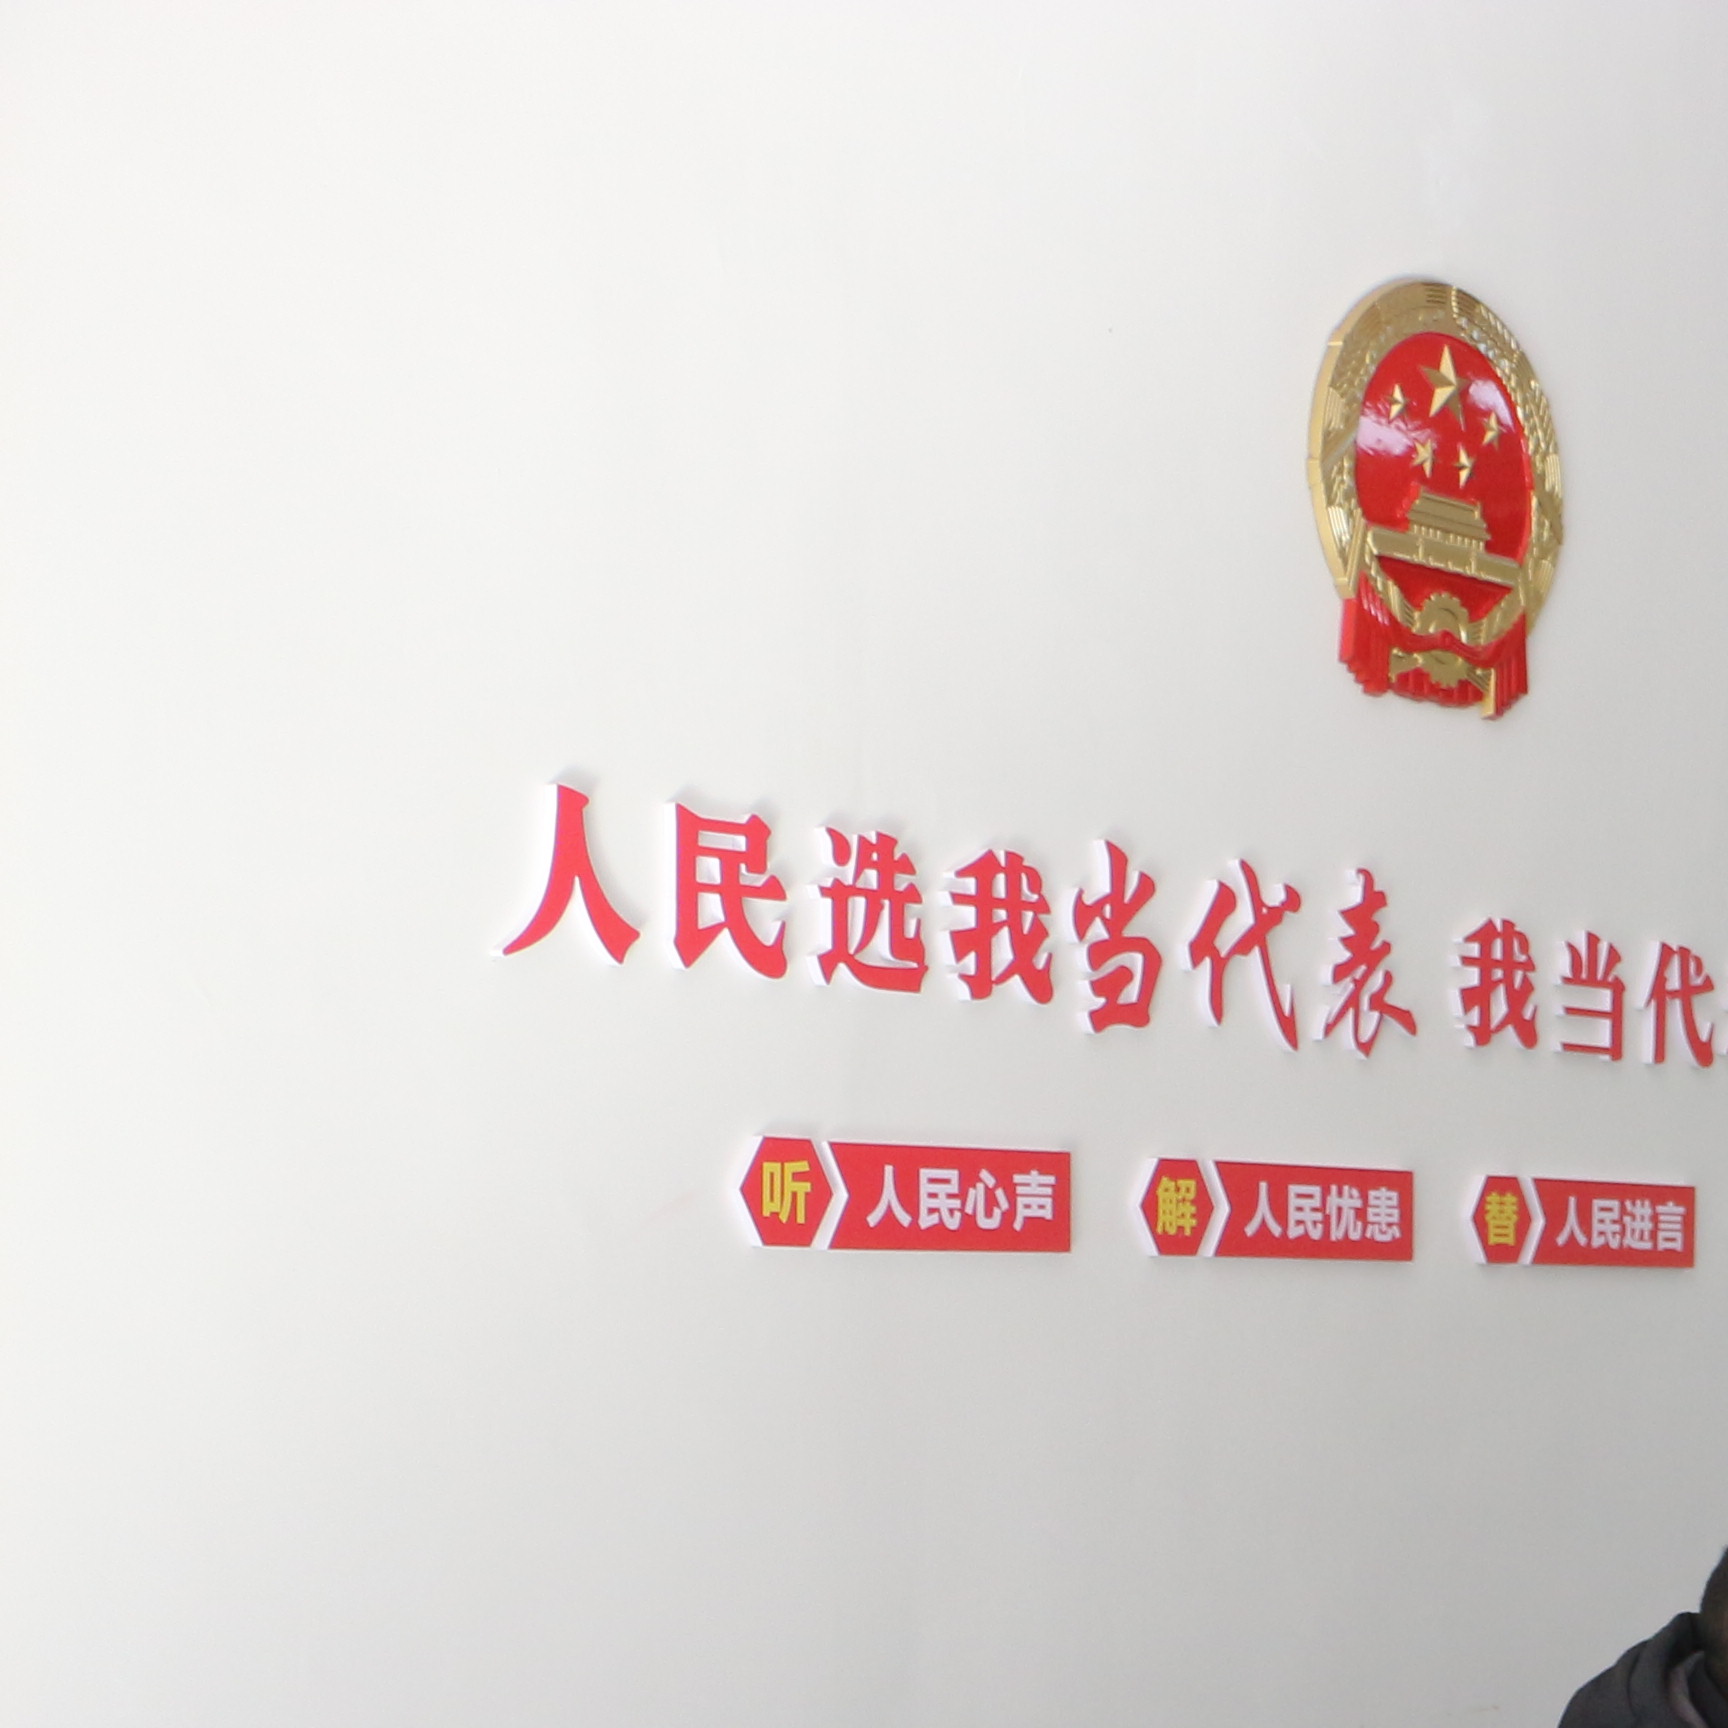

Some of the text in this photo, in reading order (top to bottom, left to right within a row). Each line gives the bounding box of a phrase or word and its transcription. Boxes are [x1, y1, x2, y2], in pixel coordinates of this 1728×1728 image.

[500, 783, 1417, 1056] 人民选我当代表
[762, 1160, 1056, 1231] 听 人民心声
[1156, 1176, 1402, 1242] 解 人民忧患
[1485, 1192, 1685, 1252] 替 人民进言
